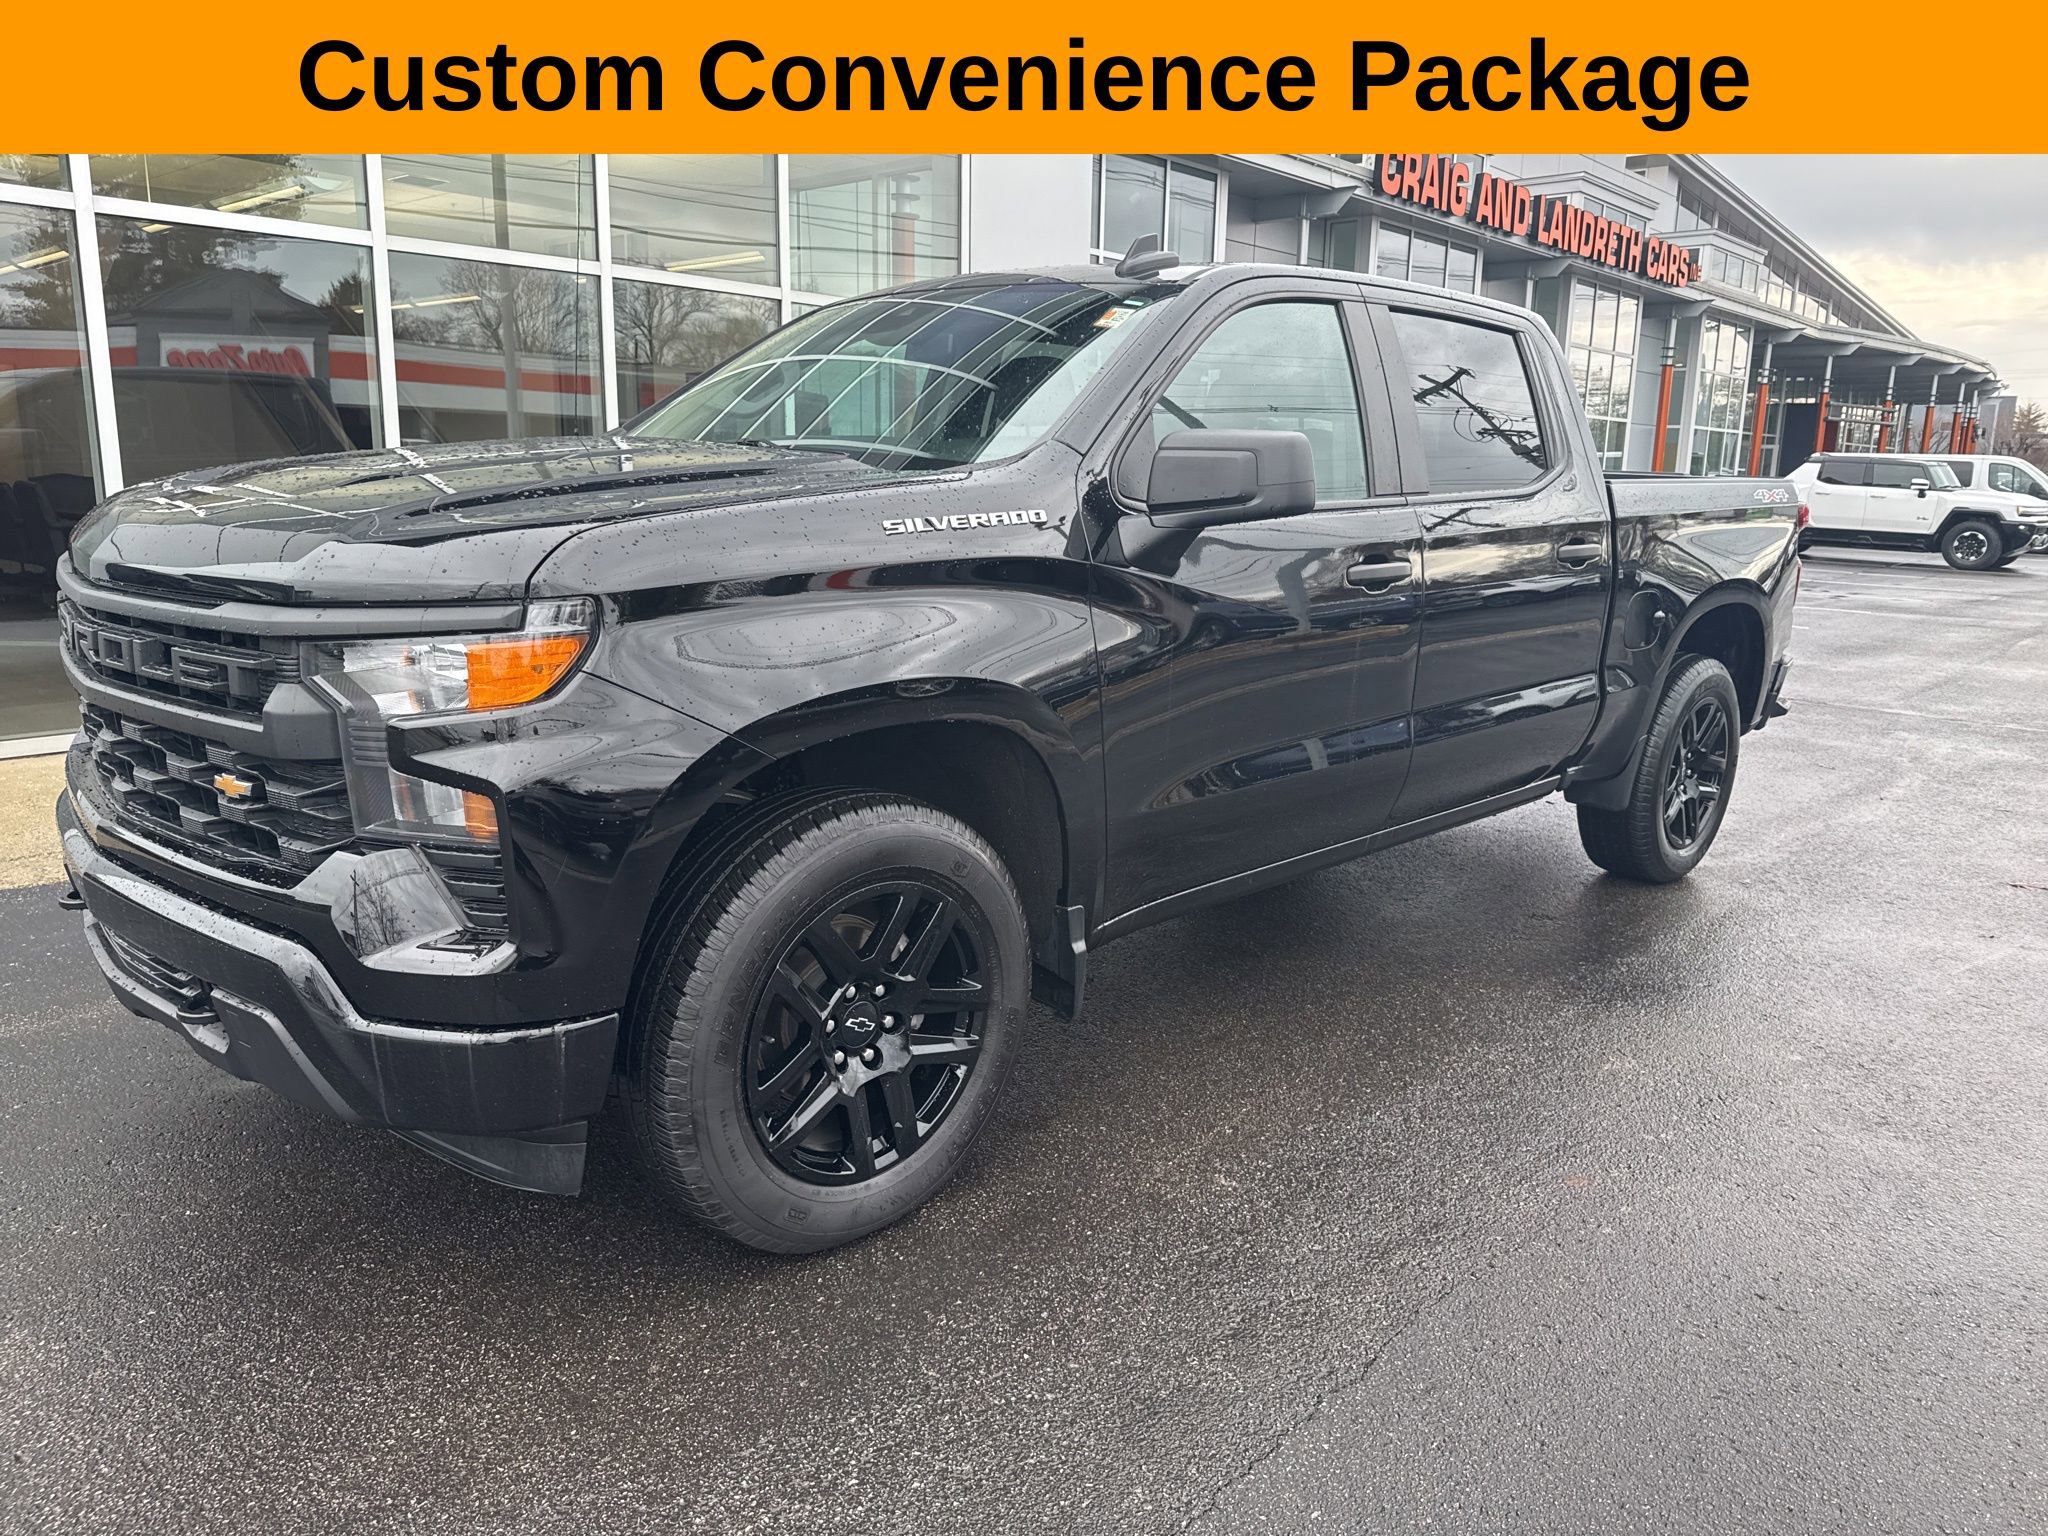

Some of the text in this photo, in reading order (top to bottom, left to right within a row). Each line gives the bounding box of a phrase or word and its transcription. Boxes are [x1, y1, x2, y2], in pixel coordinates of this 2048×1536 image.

[1381, 154, 1470, 217] CRAIG
[1476, 173, 1531, 236] AND
[1537, 194, 1644, 273] LANDRETH
[1647, 236, 1690, 288] CARS
[882, 509, 1048, 536] SILVERADO
